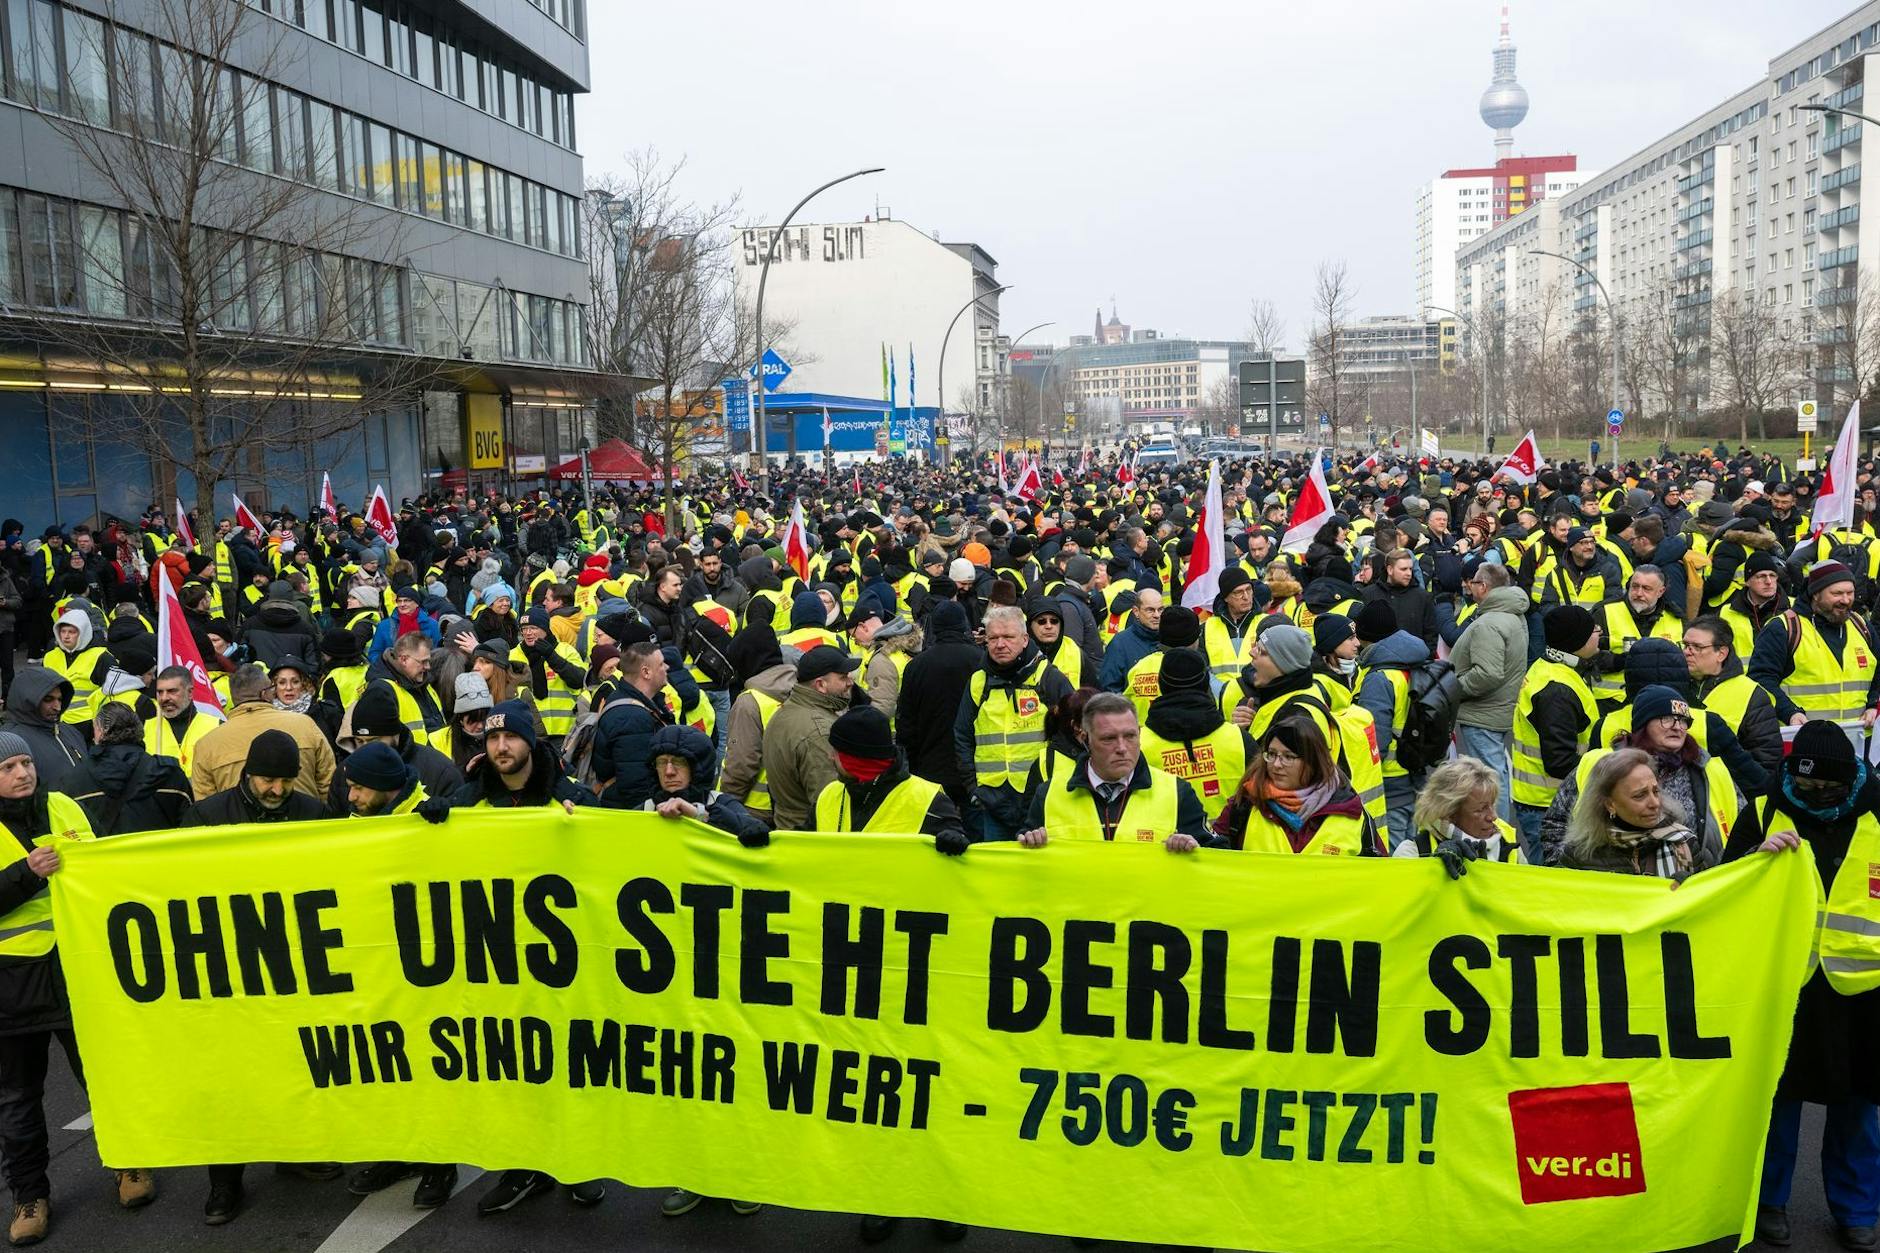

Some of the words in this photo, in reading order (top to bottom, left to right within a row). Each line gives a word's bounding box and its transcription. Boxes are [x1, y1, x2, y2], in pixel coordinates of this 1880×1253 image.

[475, 431, 500, 459] BVG
[107, 888, 356, 1005] OHNE
[390, 873, 579, 990] UNS
[986, 916, 1383, 1059] BERLIN
[1423, 930, 1734, 1061] STILL
[297, 1020, 413, 1090] WIR
[428, 1016, 554, 1085] SIND
[567, 1018, 737, 1106] MEHR
[762, 1040, 941, 1132] WERT
[1018, 1067, 1198, 1154] 750€
[1220, 1087, 1440, 1165] JETZT!
[1525, 1151, 1633, 1180] ver.di
